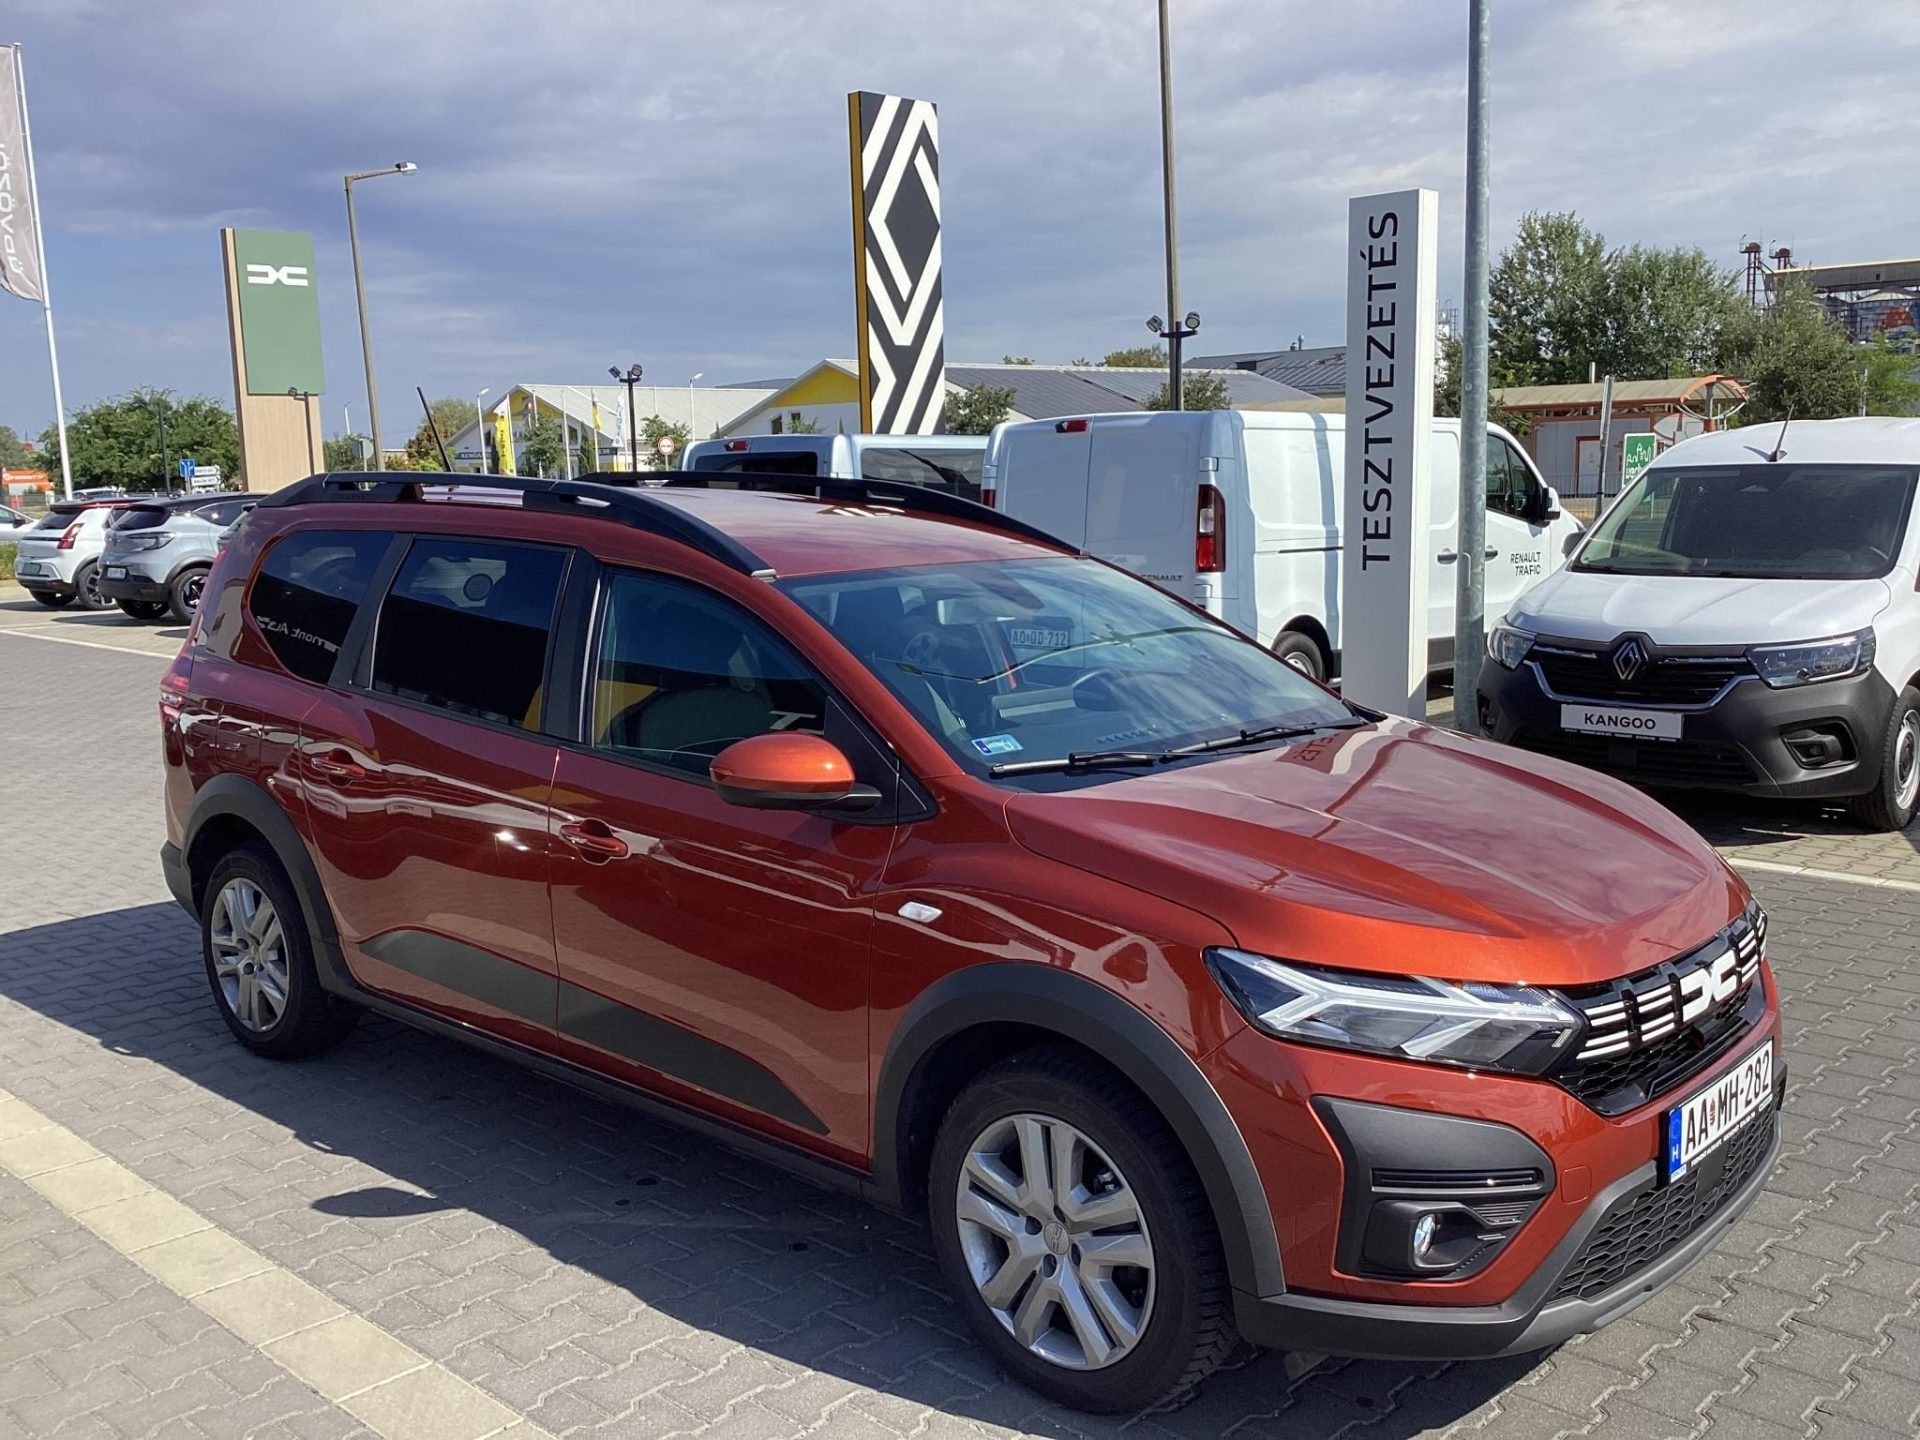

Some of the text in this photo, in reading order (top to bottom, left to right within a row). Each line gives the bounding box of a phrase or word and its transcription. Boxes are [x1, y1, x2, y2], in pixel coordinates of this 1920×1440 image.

[1360, 211, 1398, 570] TESZTVEZETÉS
[1510, 551, 1541, 564] RENAULT
[1515, 564, 1541, 576] TRAFIC
[1584, 712, 1656, 730] KANGOO
[1717, 1049, 1769, 1131] MH-282
